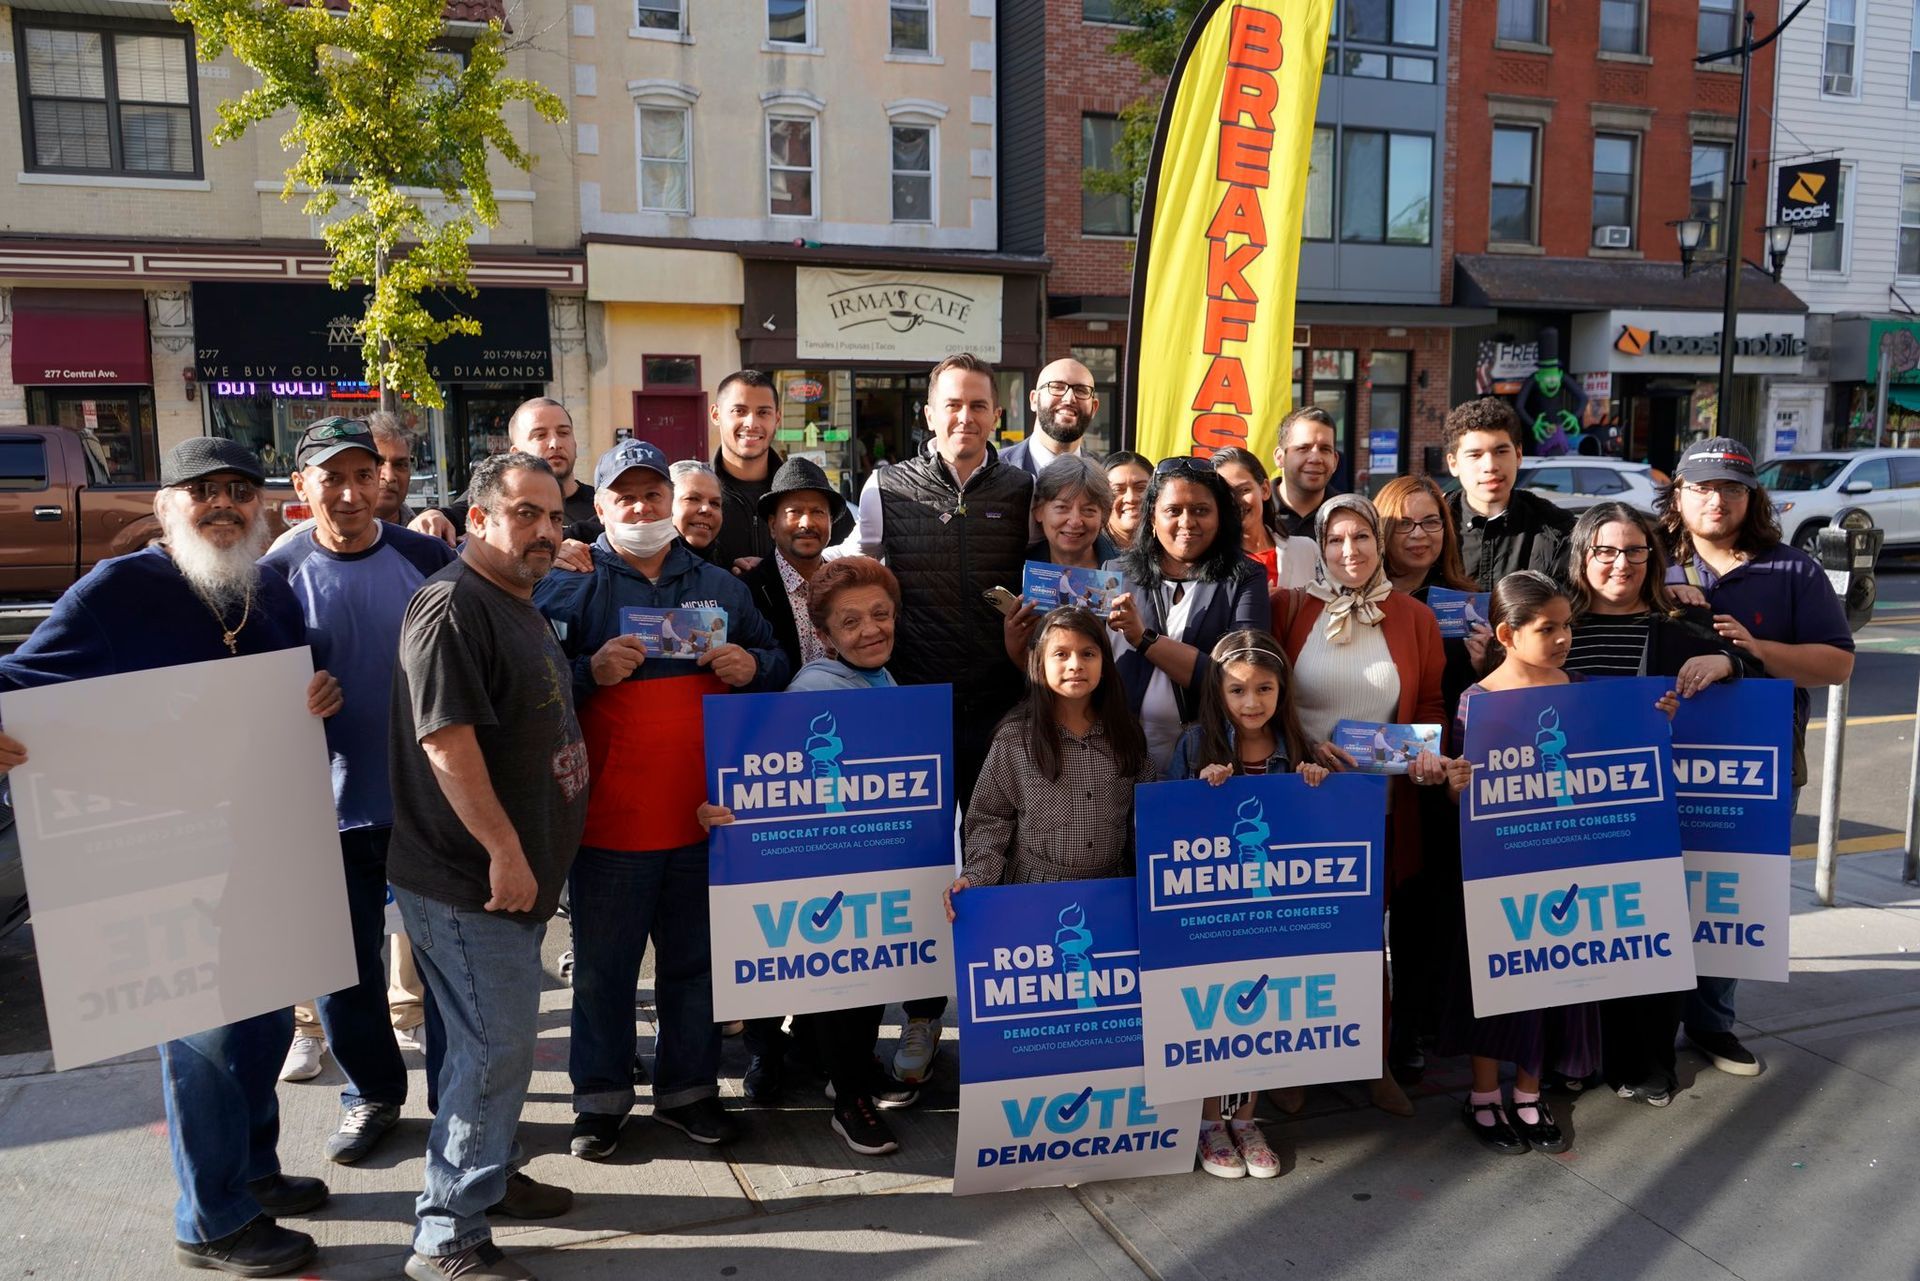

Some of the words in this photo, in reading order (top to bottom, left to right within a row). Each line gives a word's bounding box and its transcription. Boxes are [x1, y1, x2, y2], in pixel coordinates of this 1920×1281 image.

[1782, 202, 1830, 221] boost
[829, 290, 908, 319] IRMA'S
[914, 293, 972, 324] CAFÉ
[200, 350, 219, 359] 277
[483, 350, 548, 360] 201-798-7671
[805, 340, 835, 349] Tamales
[839, 342, 870, 351] Pupusas
[45, 370, 61, 378] 277
[63, 370, 97, 378] Central
[98, 370, 118, 378] Ave.
[203, 366, 230, 377] WE
[244, 366, 277, 377] BUY
[291, 366, 347, 378] GOLD,
[432, 366, 441, 377] &
[454, 366, 545, 377] DIAMONDS
[271, 381, 324, 396] GOLD
[787, 383, 823, 397] OPEN
[743, 751, 804, 777] ROB
[1488, 745, 1535, 772] ROB
[733, 771, 929, 811] MENENDEZ
[1481, 763, 1650, 805] MENENDEZ
[1677, 804, 1744, 816] CONGRESS
[752, 827, 819, 842] DEMOCRAT
[823, 825, 847, 836] FOR
[850, 820, 913, 834] CONGRESS
[1496, 821, 1555, 837] DEMOCRAT
[1556, 819, 1577, 829] FOR
[1579, 812, 1637, 827] CONGRESS
[761, 845, 805, 856] CANDIDATO
[863, 837, 906, 848] CONGRESO
[1173, 836, 1231, 862] ROB
[1504, 838, 1541, 850] CANDIDATO
[1583, 833, 1591, 841] AL
[1592, 829, 1631, 840] CONGRESO
[1163, 857, 1357, 896] MENENDEZ
[753, 889, 912, 948] VOTE
[1180, 912, 1246, 927] DEMOCRAT
[1249, 909, 1273, 920] FOR
[1276, 905, 1340, 918] CONGRESS
[1500, 882, 1645, 941] VOTE
[1189, 929, 1231, 941] CANDIDATO
[1279, 924, 1288, 932] AL
[1289, 921, 1331, 932] CONGRESO
[735, 939, 937, 984] DEMOCRATIC
[993, 944, 1054, 971] ROB
[1488, 932, 1672, 979] DEMOCRATIC
[984, 968, 1141, 1007] MENEND
[1180, 974, 1336, 1031] VOTE
[1003, 1024, 1071, 1040] DEMOCRAT
[1074, 1021, 1098, 1033] FOR
[1012, 1042, 1056, 1054] CANDIDATO
[1165, 1023, 1360, 1068] DEMOCRATIC
[1001, 1087, 1158, 1138] VOTE
[977, 1128, 1179, 1168] DEMOCRATIC
